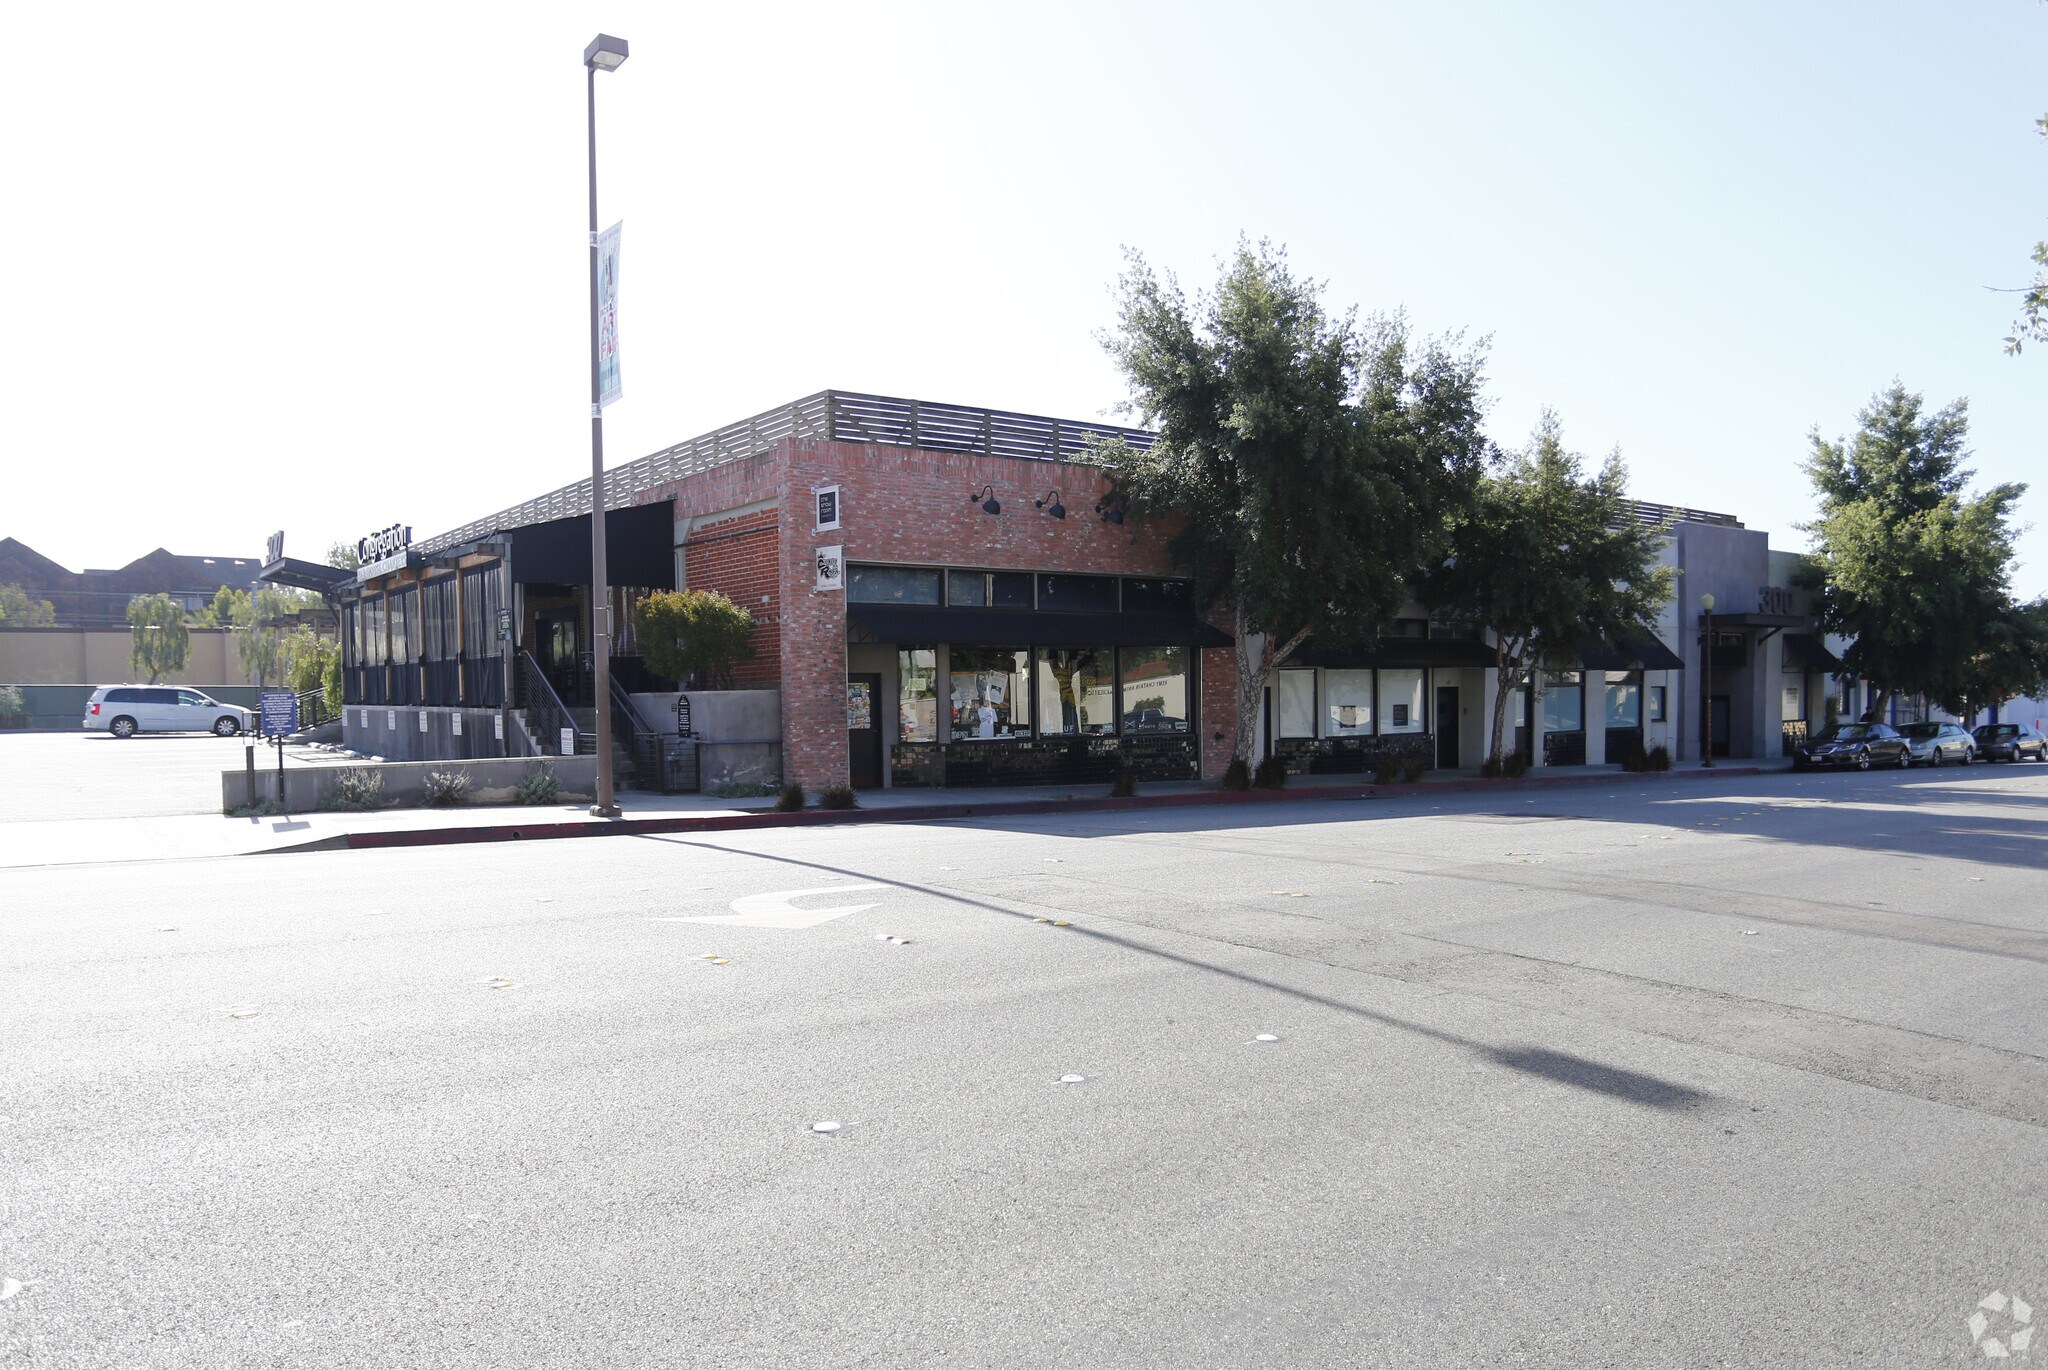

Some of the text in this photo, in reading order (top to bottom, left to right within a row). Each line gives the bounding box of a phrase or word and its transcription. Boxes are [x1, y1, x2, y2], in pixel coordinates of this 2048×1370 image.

[266, 530, 284, 565] 300
[358, 524, 412, 565] Congregation
[1758, 586, 1793, 614] 300
